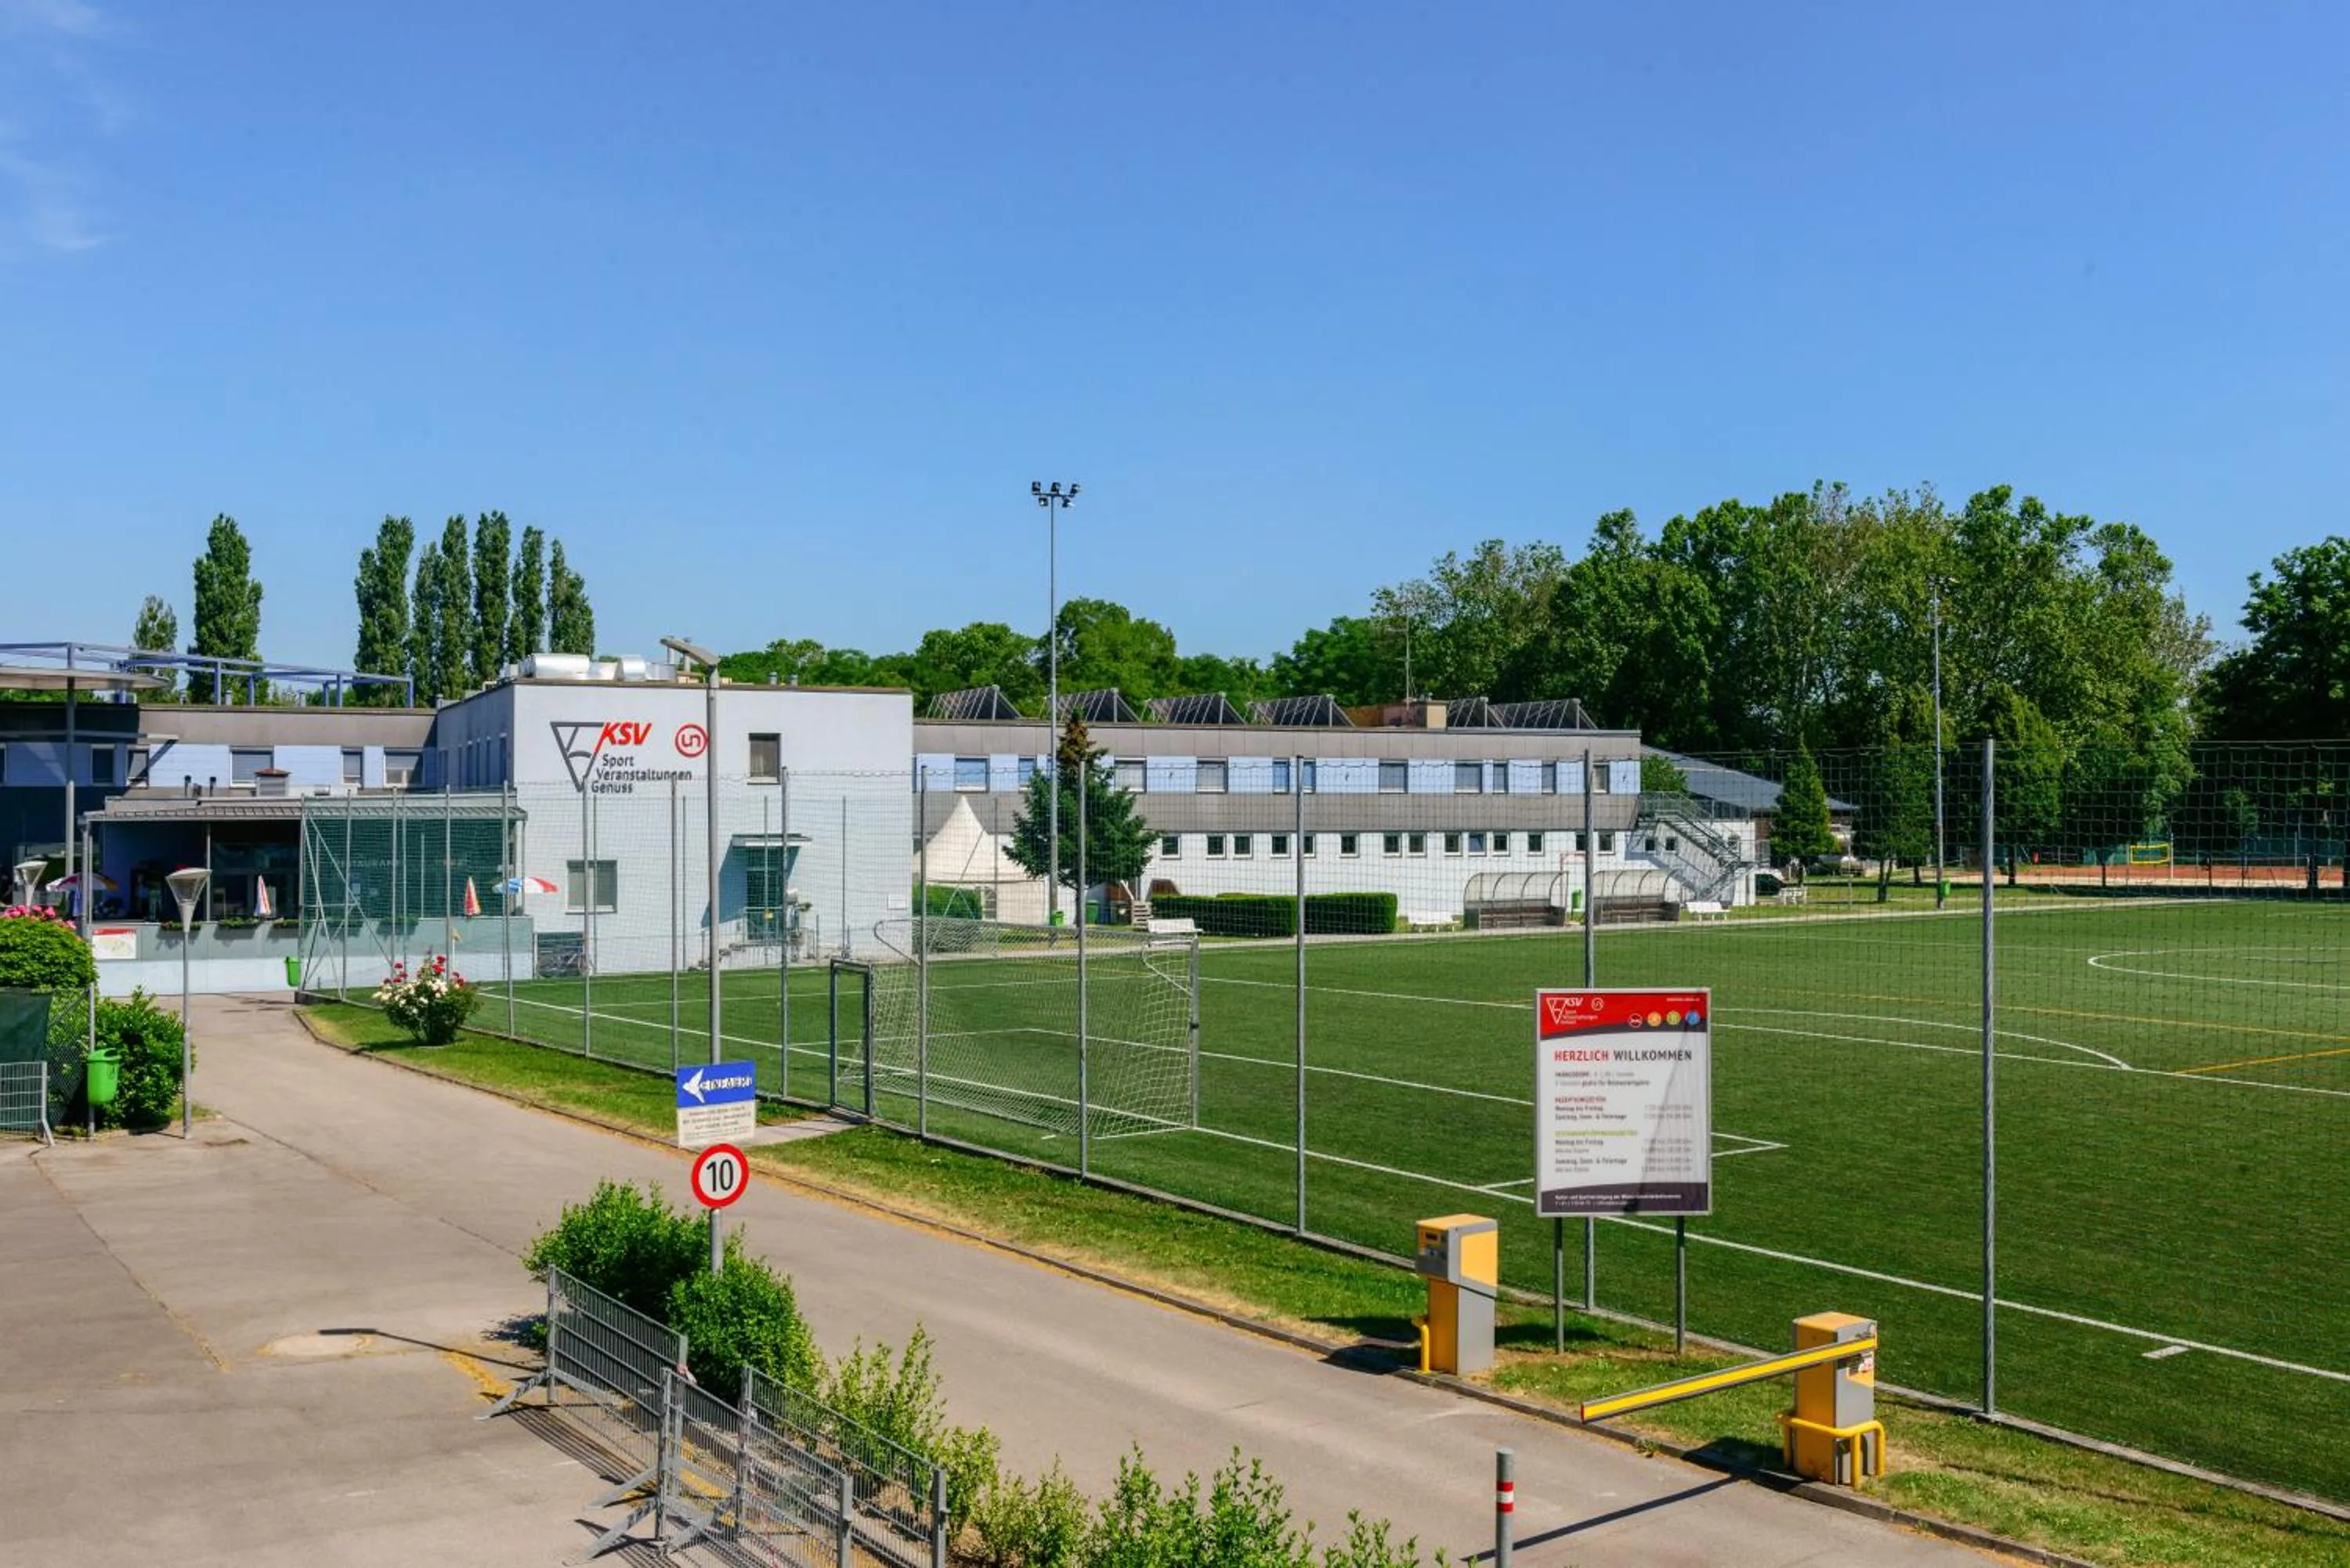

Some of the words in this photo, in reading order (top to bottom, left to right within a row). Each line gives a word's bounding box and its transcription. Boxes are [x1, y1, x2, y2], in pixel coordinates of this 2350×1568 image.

[598, 722, 653, 746] KSV
[602, 754, 634, 768] Sport
[591, 781, 633, 793] Genuss
[1554, 1050, 1608, 1061] HERZLICH
[1614, 1050, 1692, 1061] WILLKOMMEN
[707, 1159, 733, 1192] 10
